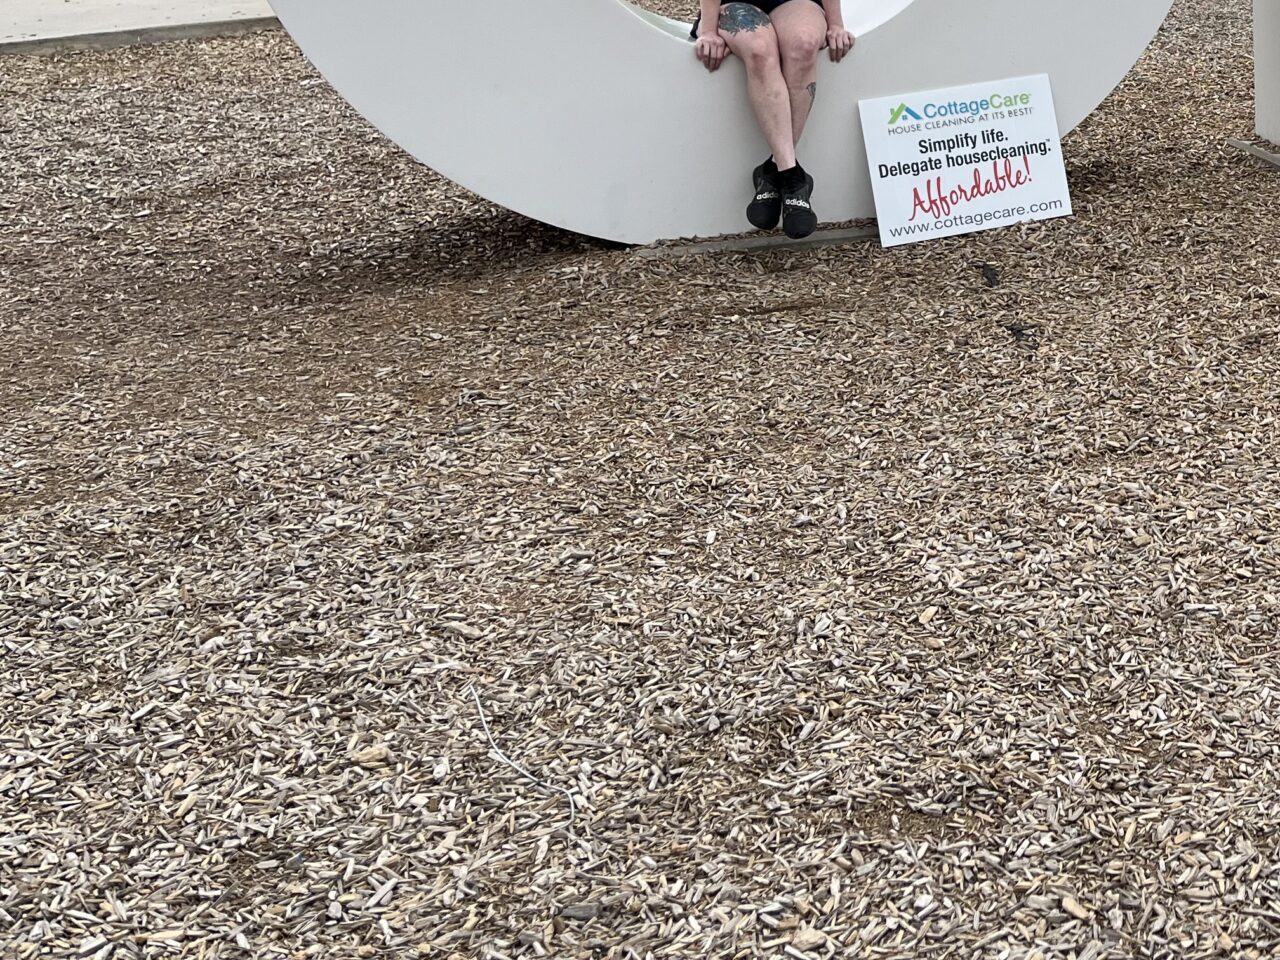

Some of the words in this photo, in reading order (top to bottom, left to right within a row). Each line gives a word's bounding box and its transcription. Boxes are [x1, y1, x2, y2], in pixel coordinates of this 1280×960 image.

[923, 93, 1030, 120] CottageCare
[888, 123, 922, 136] HOUSE
[924, 115, 975, 130] CLEANING
[978, 113, 989, 122] AT
[992, 110, 1005, 119] ITS
[918, 132, 978, 155] Simplify
[980, 128, 1009, 145] life.
[878, 157, 943, 179] Delegate
[756, 191, 779, 200] adida
[908, 154, 1033, 222] Affordable!
[889, 198, 1063, 237] www.cottagecare.com
